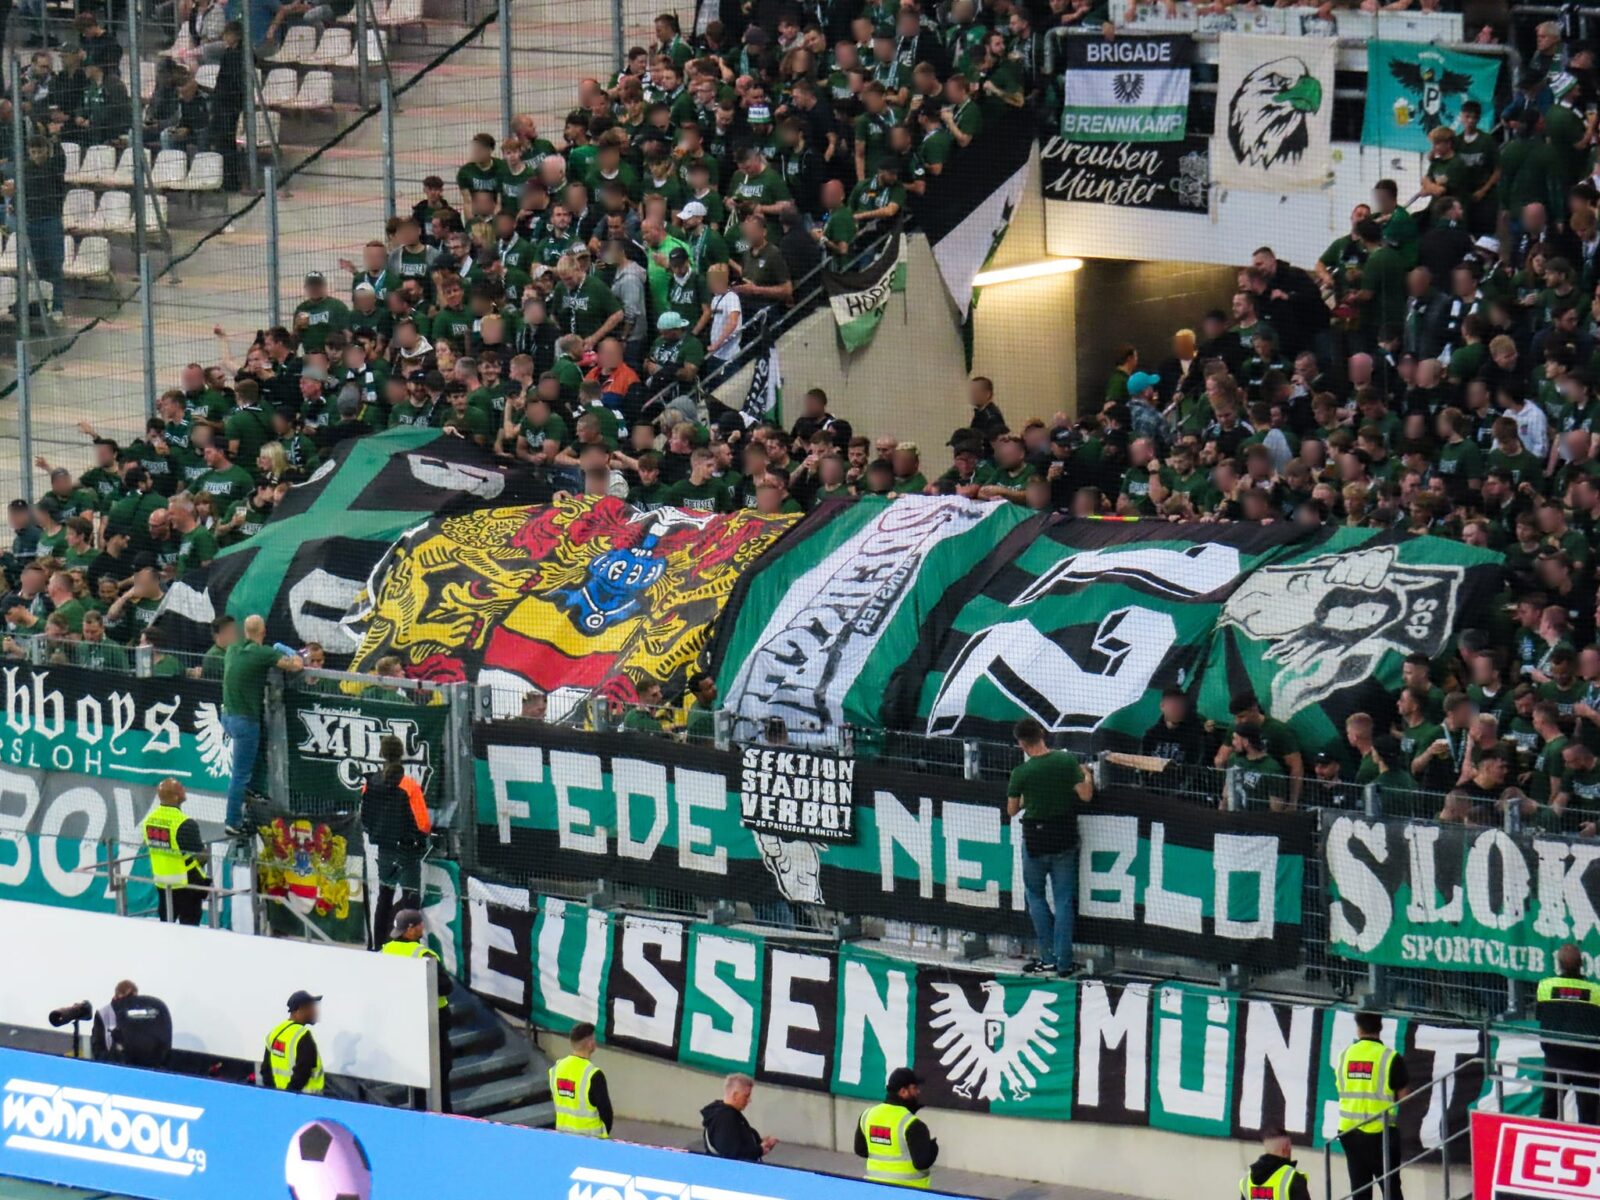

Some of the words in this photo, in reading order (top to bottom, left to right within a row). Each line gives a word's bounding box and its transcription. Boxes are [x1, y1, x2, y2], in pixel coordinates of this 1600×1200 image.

[1086, 43, 1171, 62] BRIGADE
[1064, 114, 1183, 134] BRENNKAMP
[1046, 168, 1165, 205] Münster
[1405, 598, 1438, 640] SCP
[0, 736, 102, 775] SLOH
[339, 757, 428, 786] CRW
[742, 748, 855, 782] SEKTION
[741, 769, 853, 804] STADION
[487, 744, 728, 875] FEDE
[740, 792, 852, 831] VERBOT
[874, 790, 1280, 940] NEBLO
[364, 840, 909, 1088] REUSSEN
[1401, 934, 1546, 974] SPORTCLUB
[1521, 1142, 1600, 1188] ES
